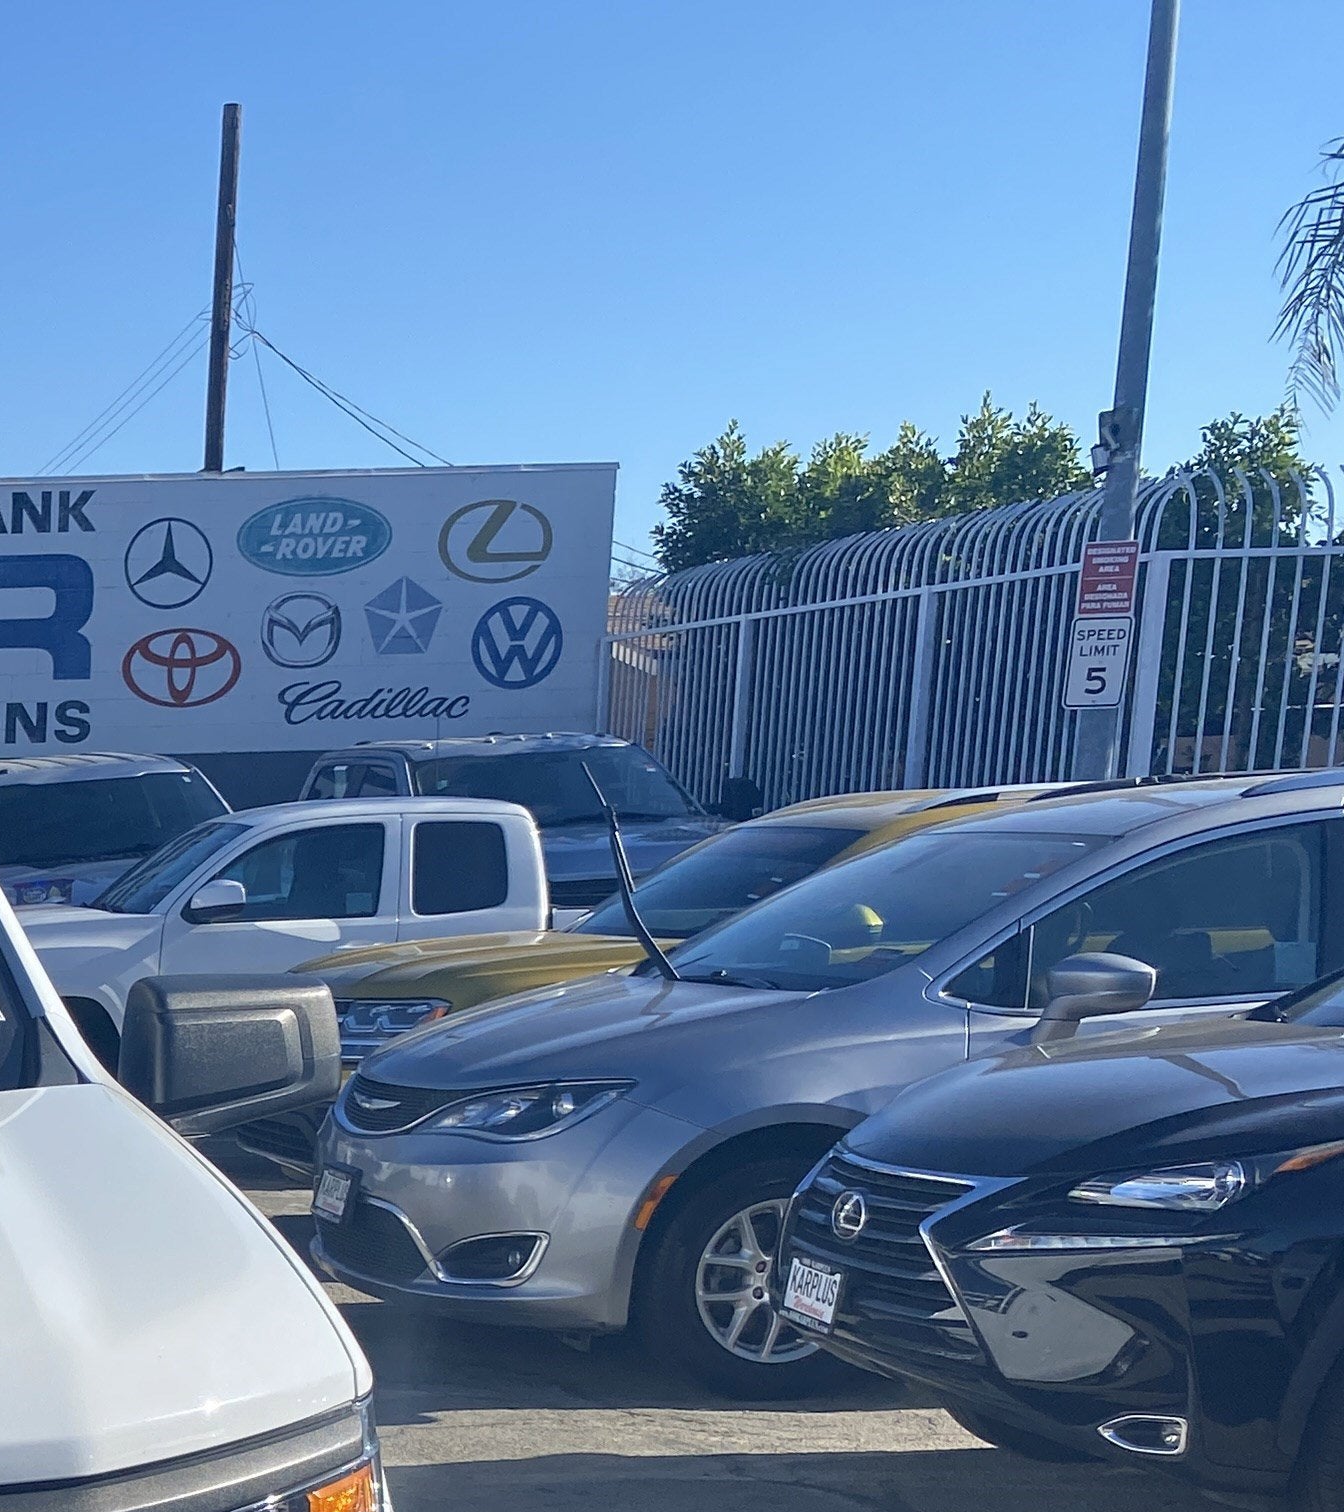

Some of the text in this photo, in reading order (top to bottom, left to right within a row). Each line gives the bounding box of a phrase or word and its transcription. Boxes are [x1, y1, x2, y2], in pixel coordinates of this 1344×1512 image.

[1076, 628, 1127, 641] SPEED
[1079, 644, 1120, 657] LIMIT
[1084, 666, 1107, 695] 5
[277, 680, 470, 726] Cadillac
[790, 1264, 838, 1307] KARPLUS
